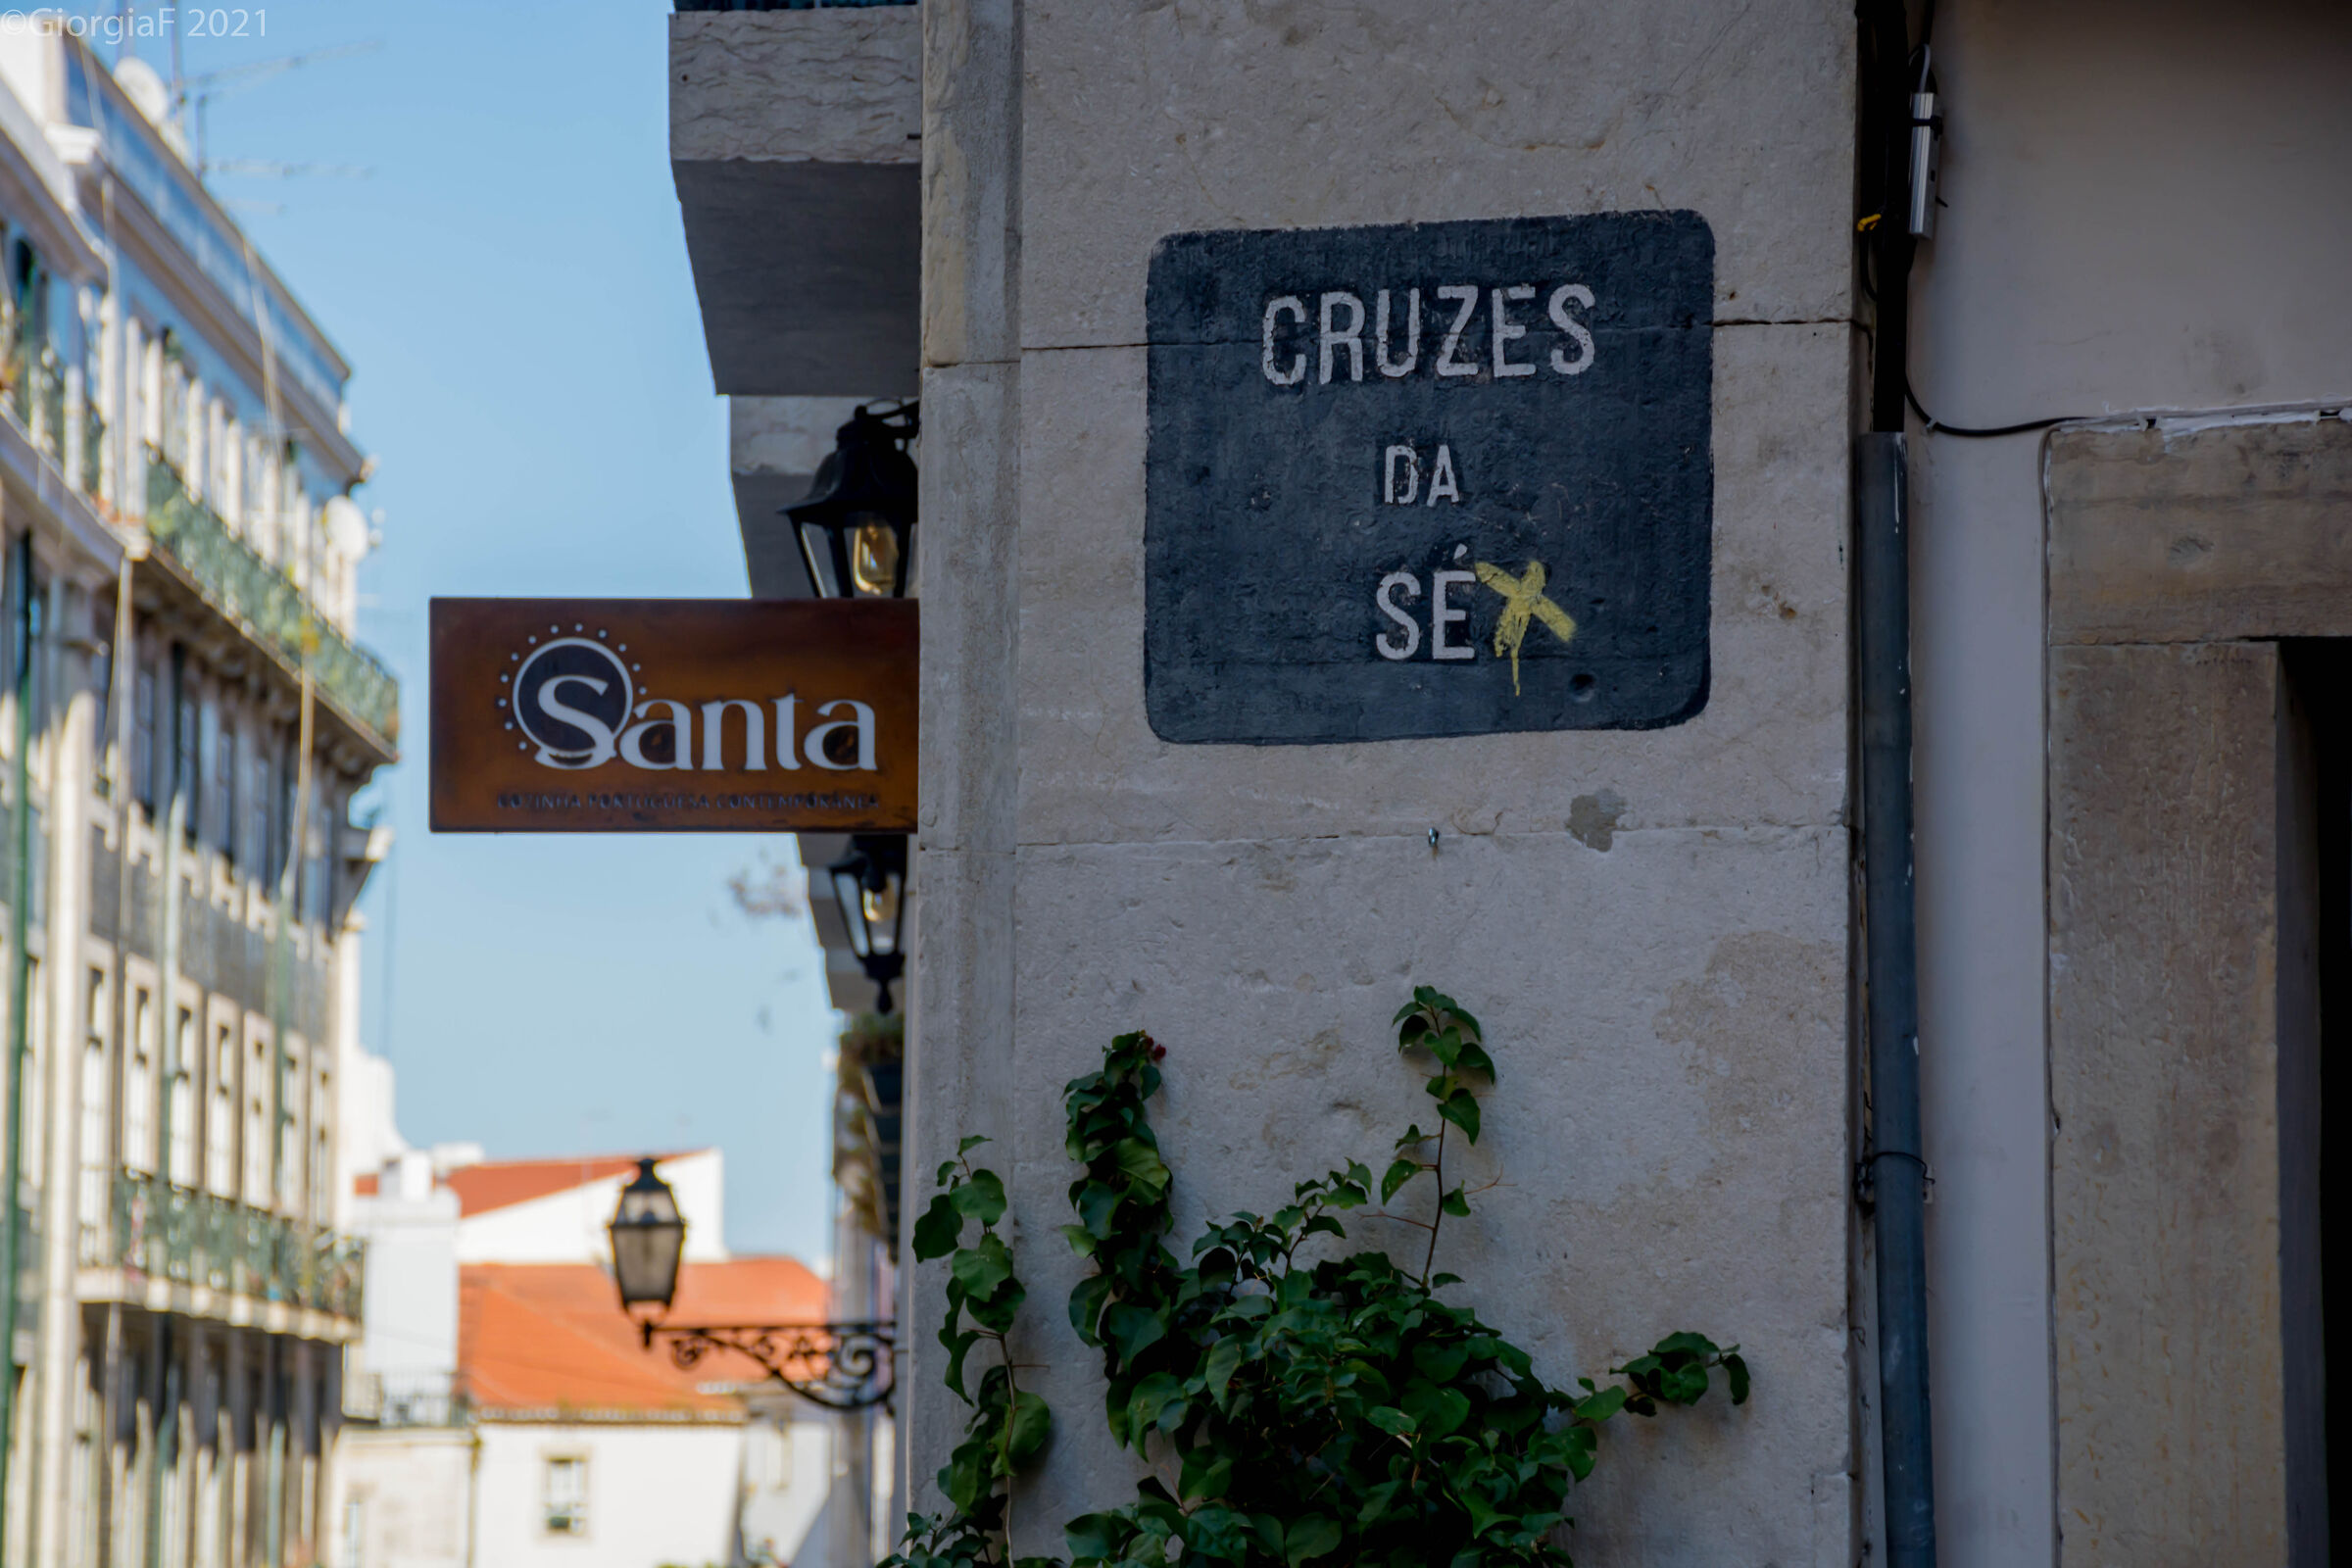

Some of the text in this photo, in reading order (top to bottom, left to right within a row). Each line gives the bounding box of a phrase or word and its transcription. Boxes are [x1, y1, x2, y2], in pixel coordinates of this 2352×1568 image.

[1261, 283, 1596, 385] CRUZES
[1384, 443, 1460, 508] DA
[1375, 544, 1477, 662] SÉ
[533, 675, 878, 771] Santa
[496, 791, 582, 808] COZINHA
[588, 791, 710, 808] PORTUGUESA
